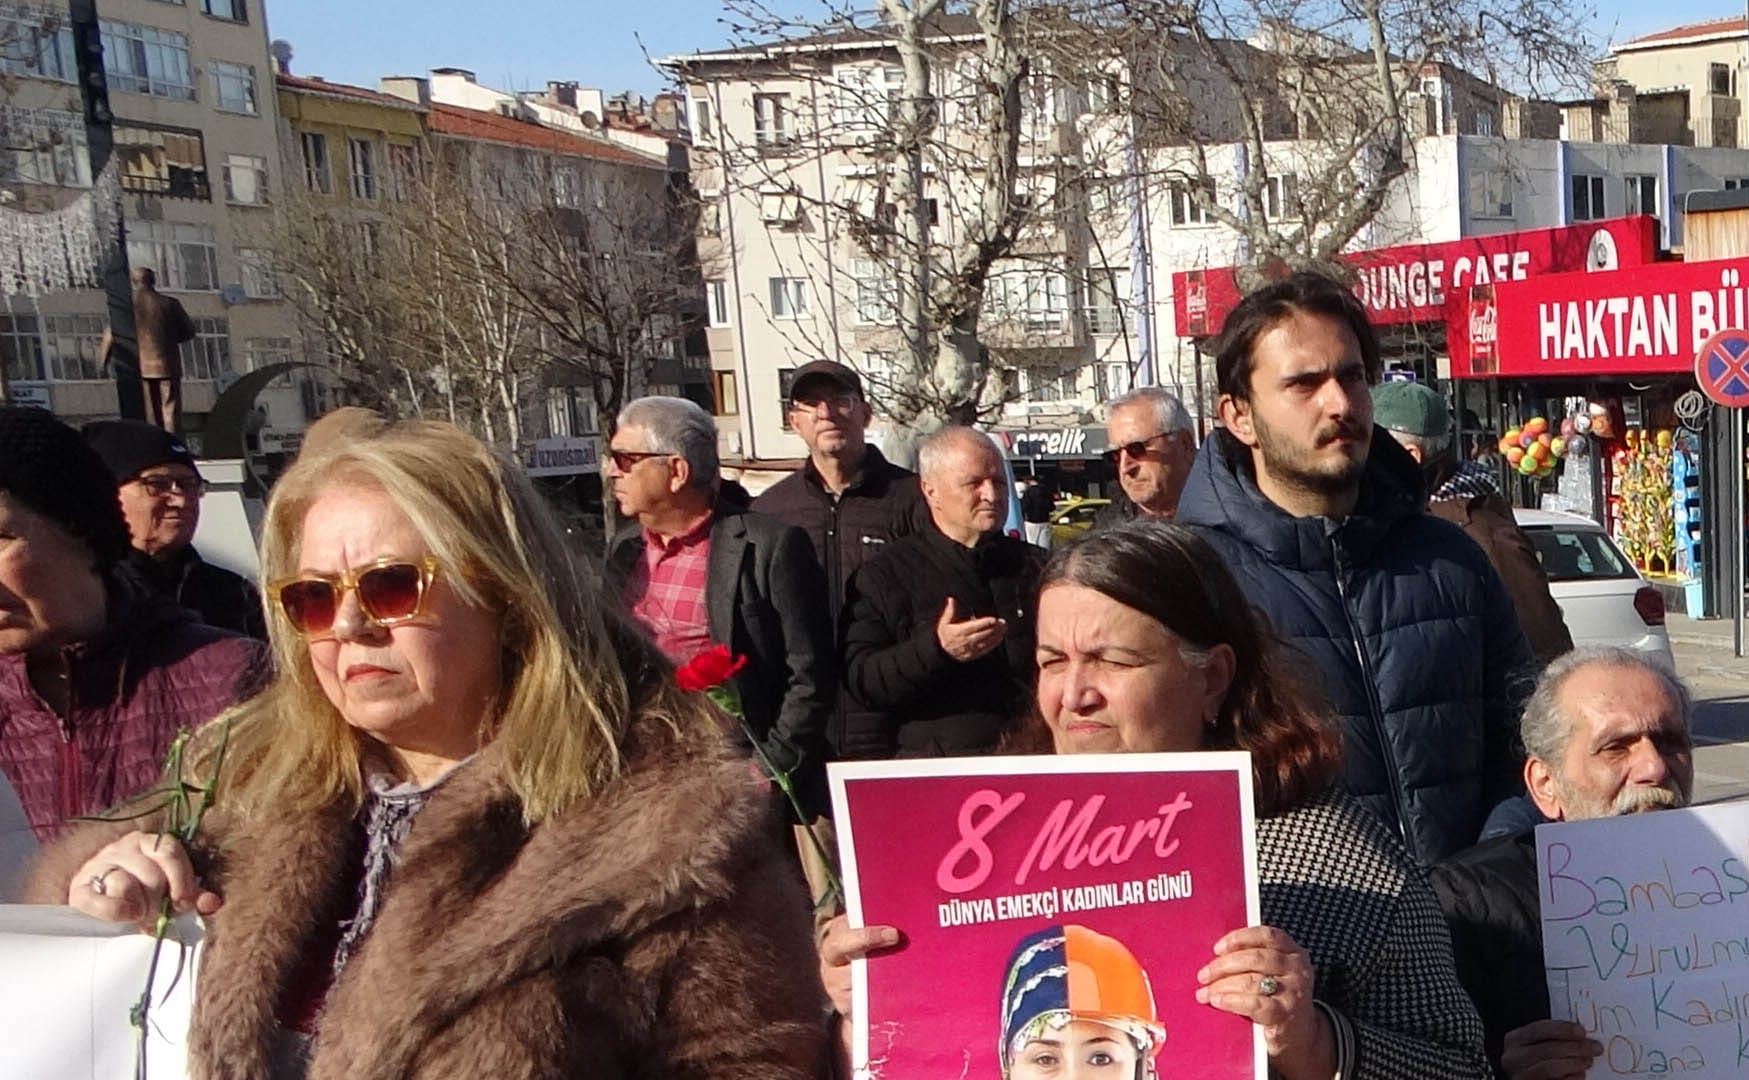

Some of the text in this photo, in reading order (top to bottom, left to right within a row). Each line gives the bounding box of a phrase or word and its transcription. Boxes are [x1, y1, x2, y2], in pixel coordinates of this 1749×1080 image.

[1539, 293, 1678, 361] HAKTAN
[936, 790, 1192, 893] 8 Mart
[938, 871, 1193, 927] DÜNYA EMEKÇİ KADINLAR GÜNÜ
